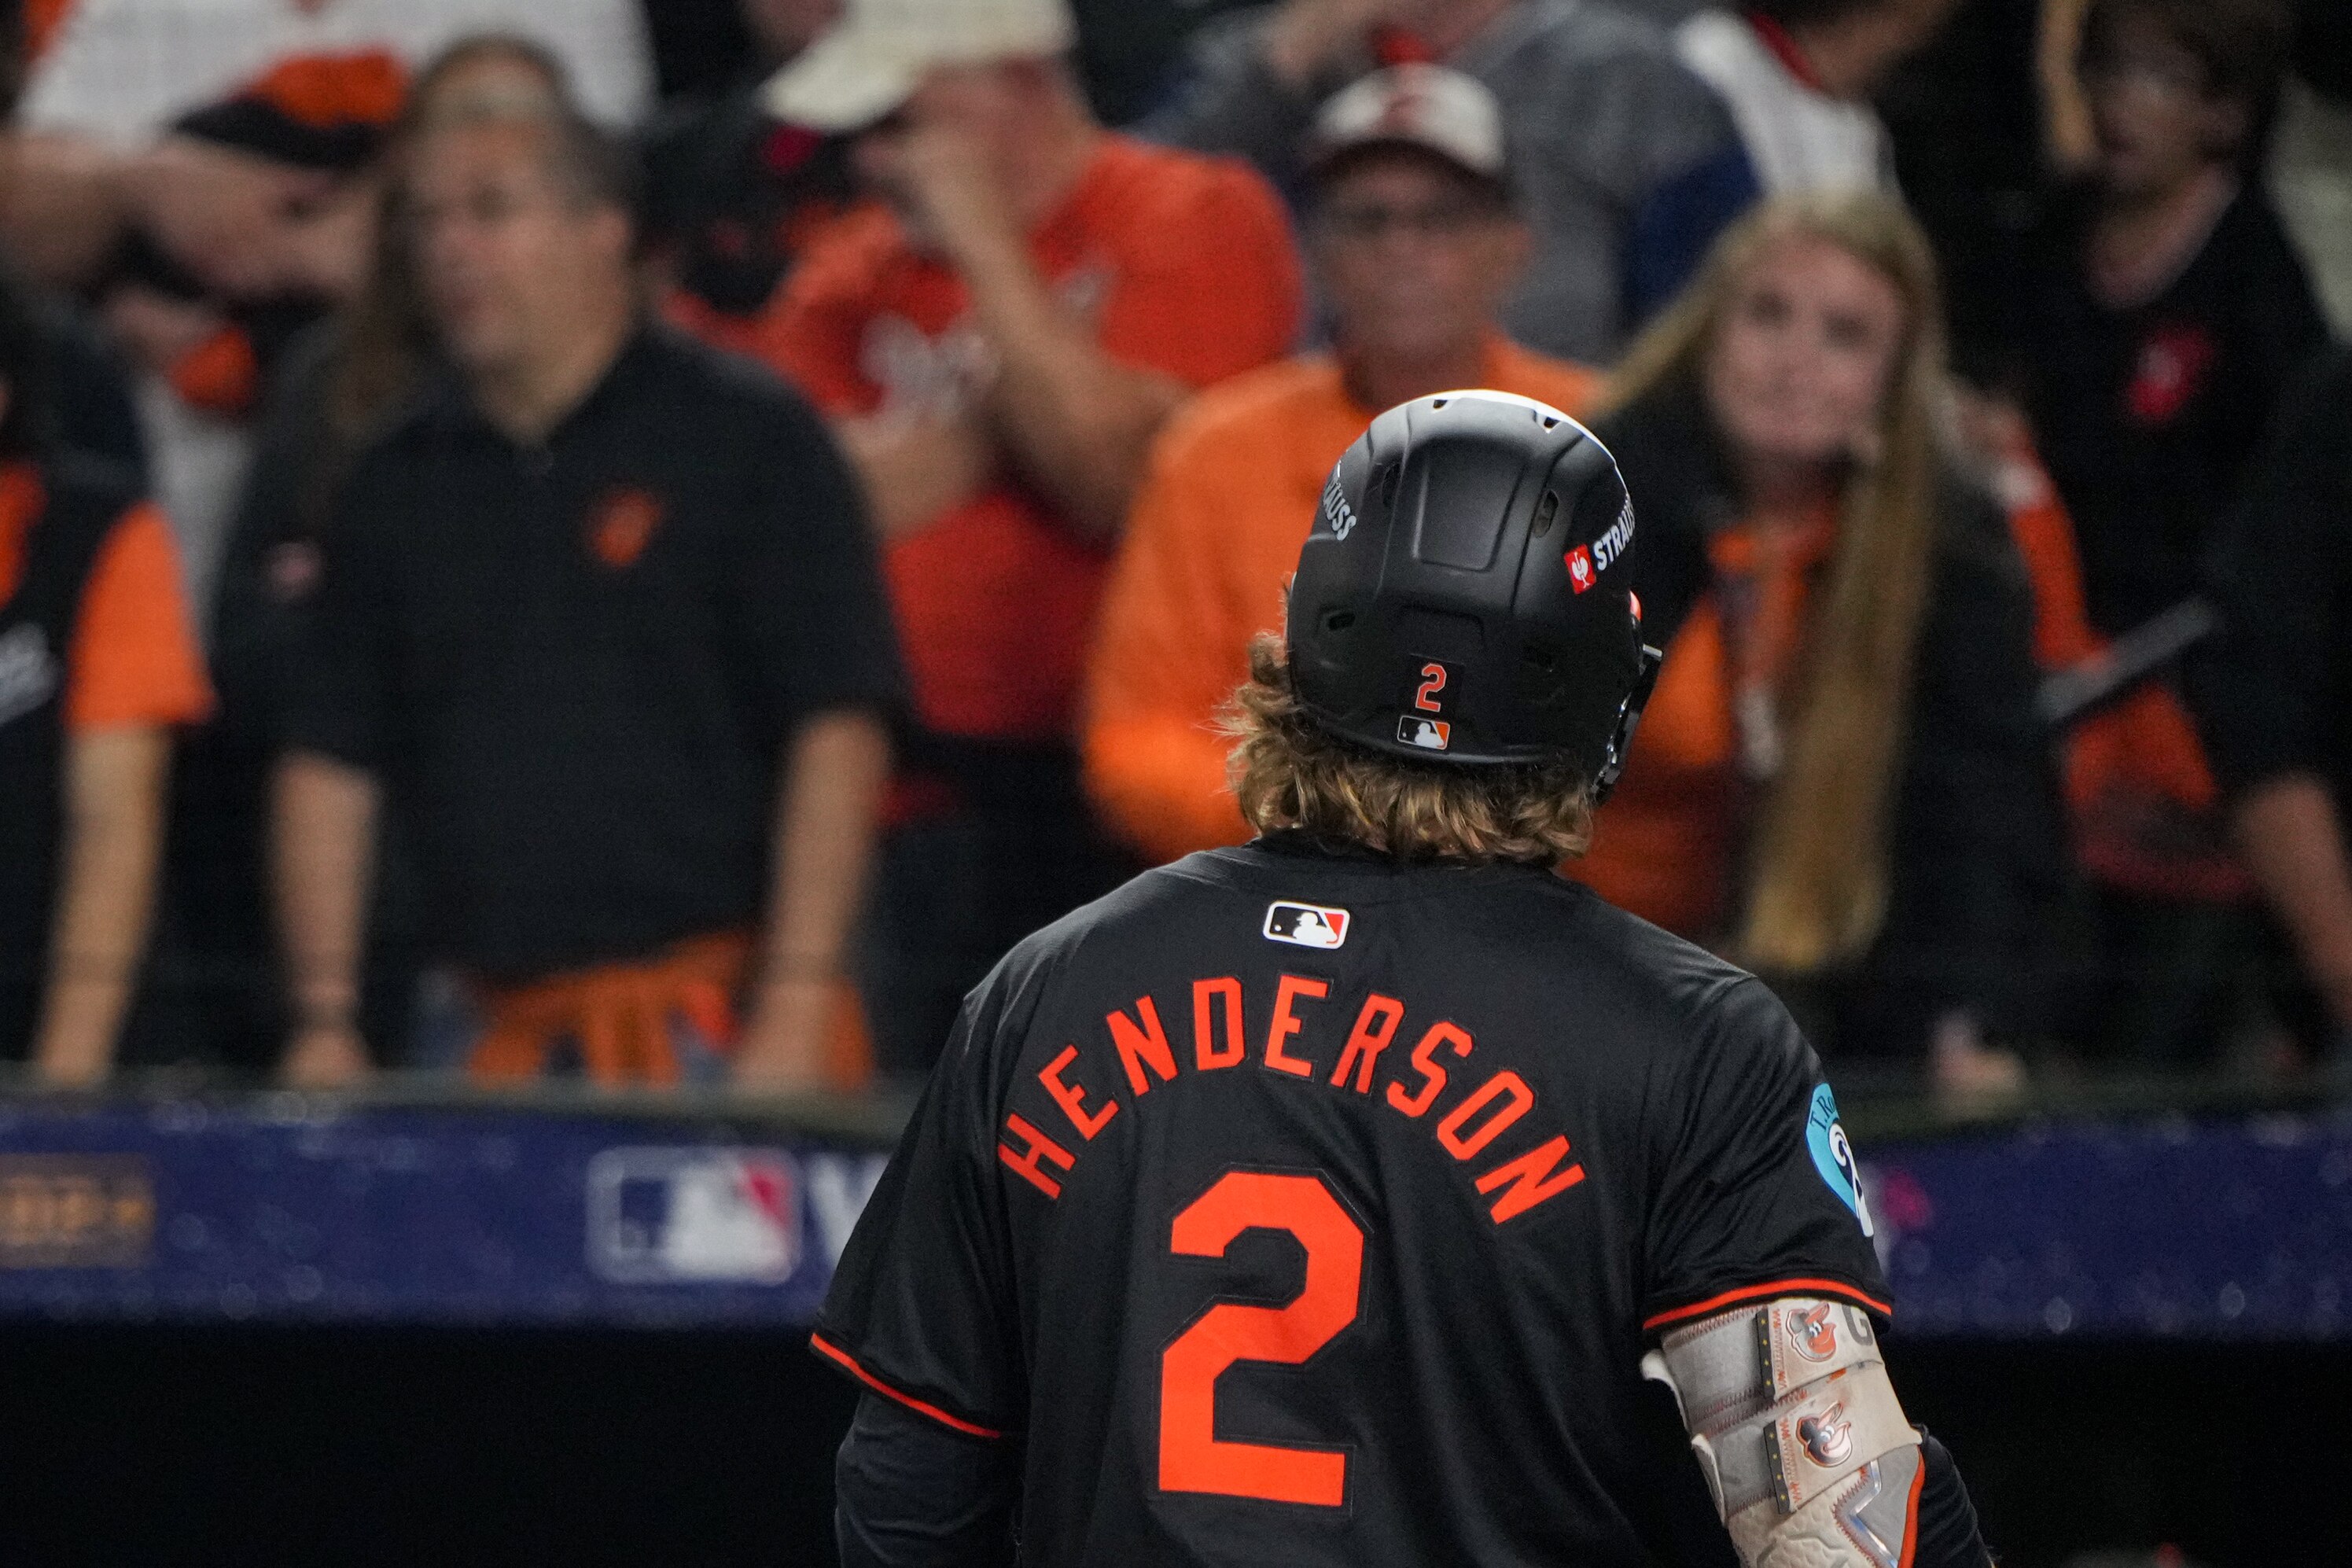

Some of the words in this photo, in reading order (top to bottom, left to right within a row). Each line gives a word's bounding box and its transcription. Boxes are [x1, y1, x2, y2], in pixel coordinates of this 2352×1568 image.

[1415, 663, 1447, 712] 2
[999, 974, 1585, 1225] HENDERSON
[1159, 1172, 1364, 1506] 2
